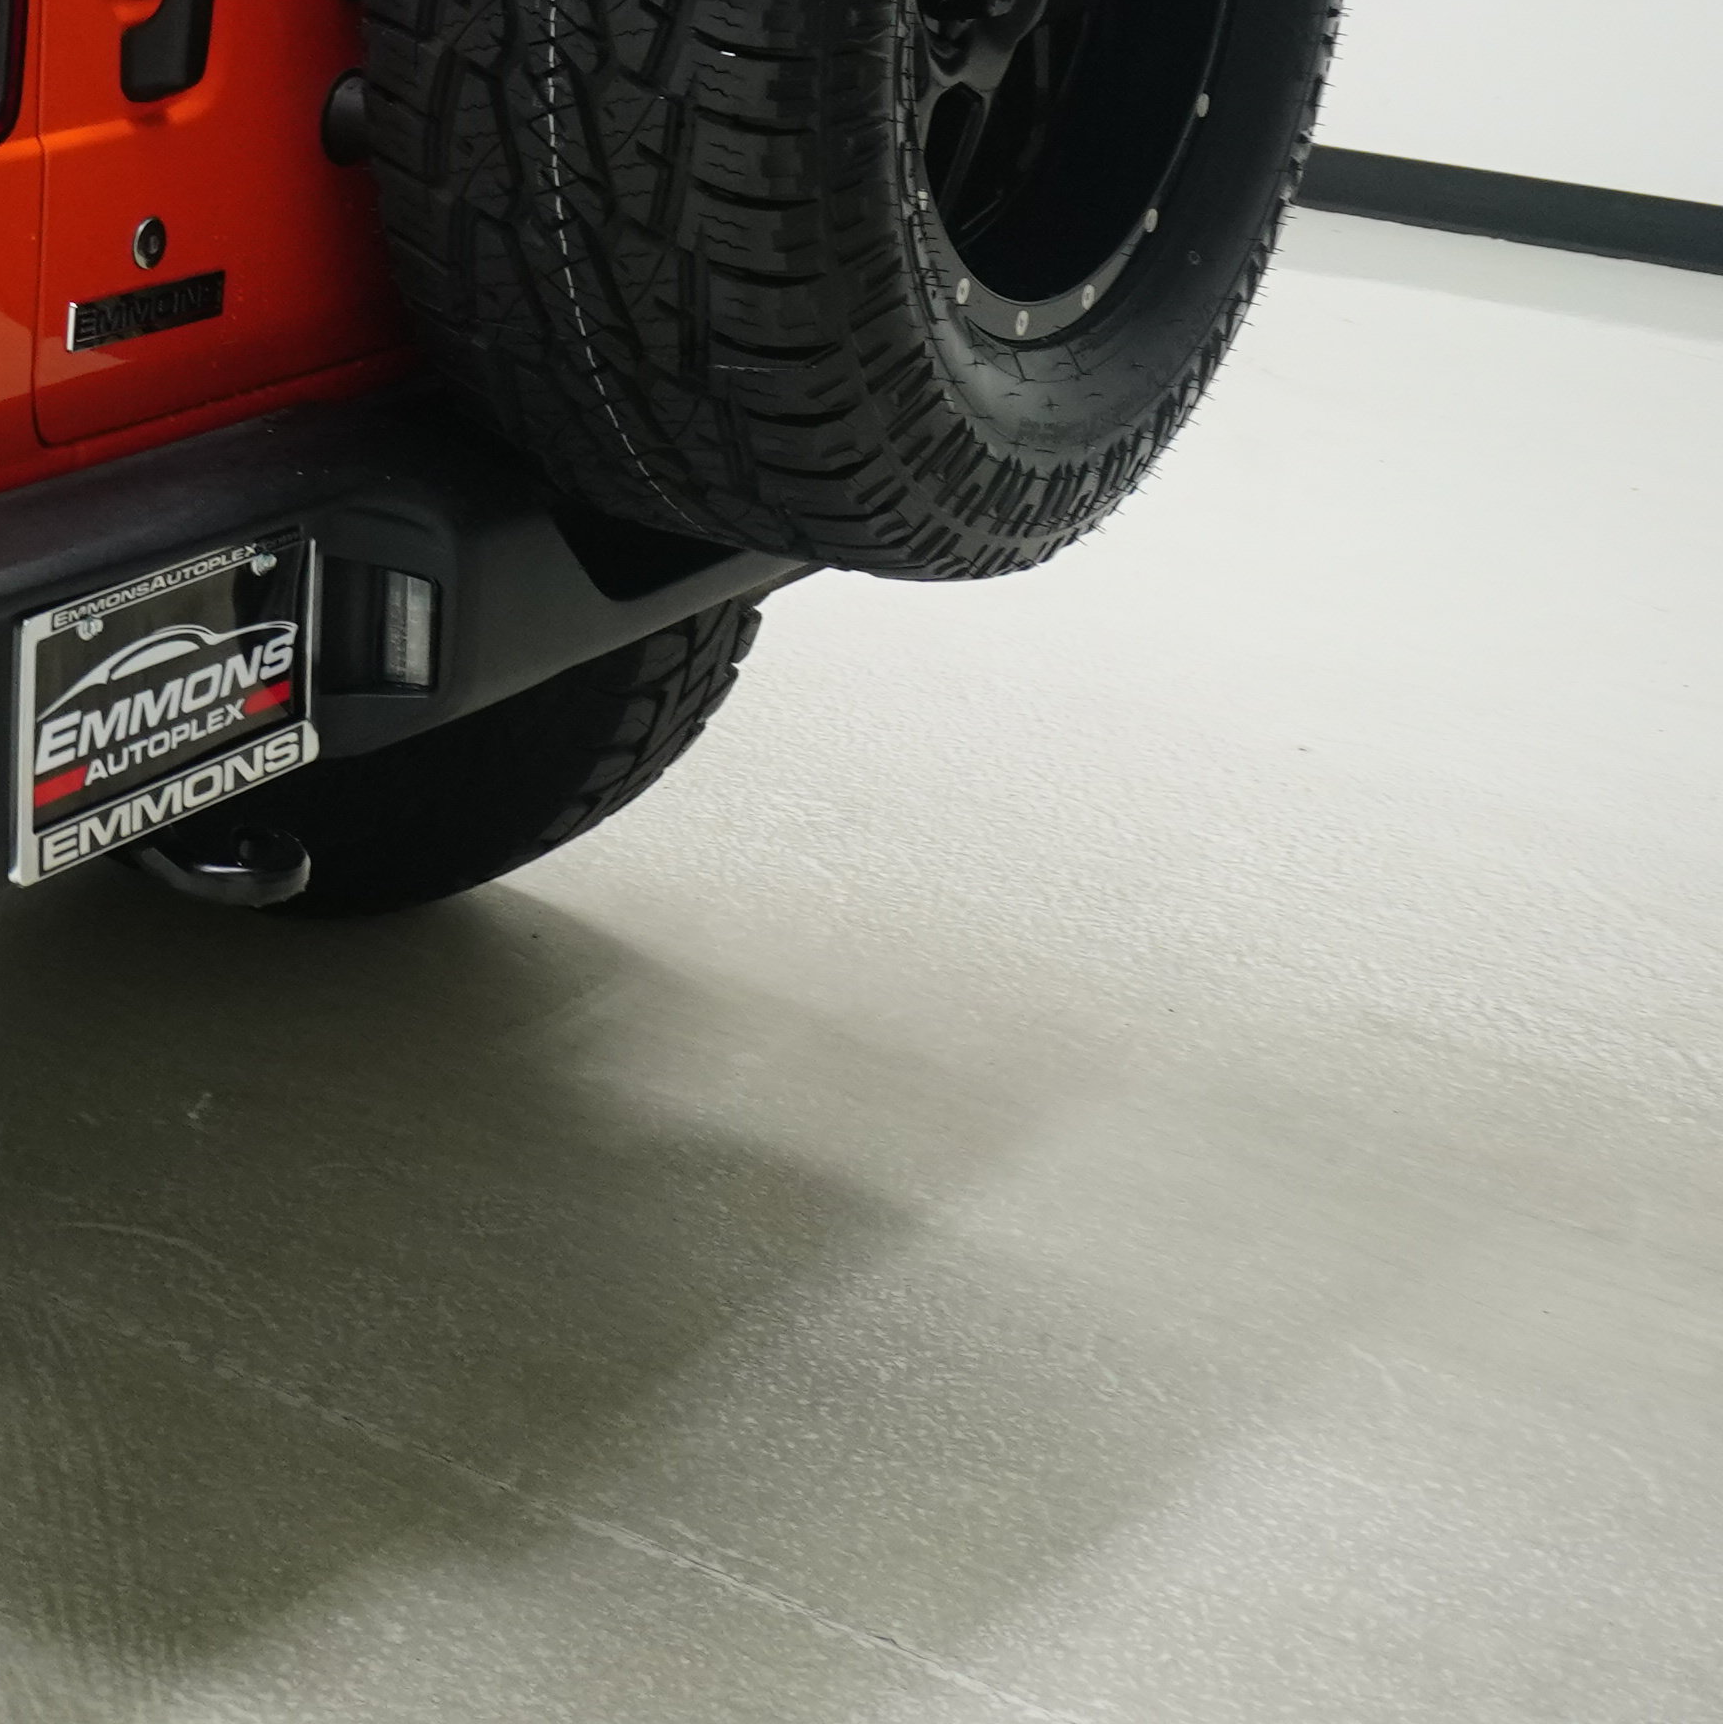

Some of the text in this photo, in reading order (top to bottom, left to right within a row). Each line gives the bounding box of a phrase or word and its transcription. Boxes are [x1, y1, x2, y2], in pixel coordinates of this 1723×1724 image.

[54, 536, 299, 628] EMMONSAUTOPLEX
[35, 632, 294, 775] EMMONS
[84, 698, 247, 786] AUTOPLEX
[42, 732, 300, 871] EMMONS
